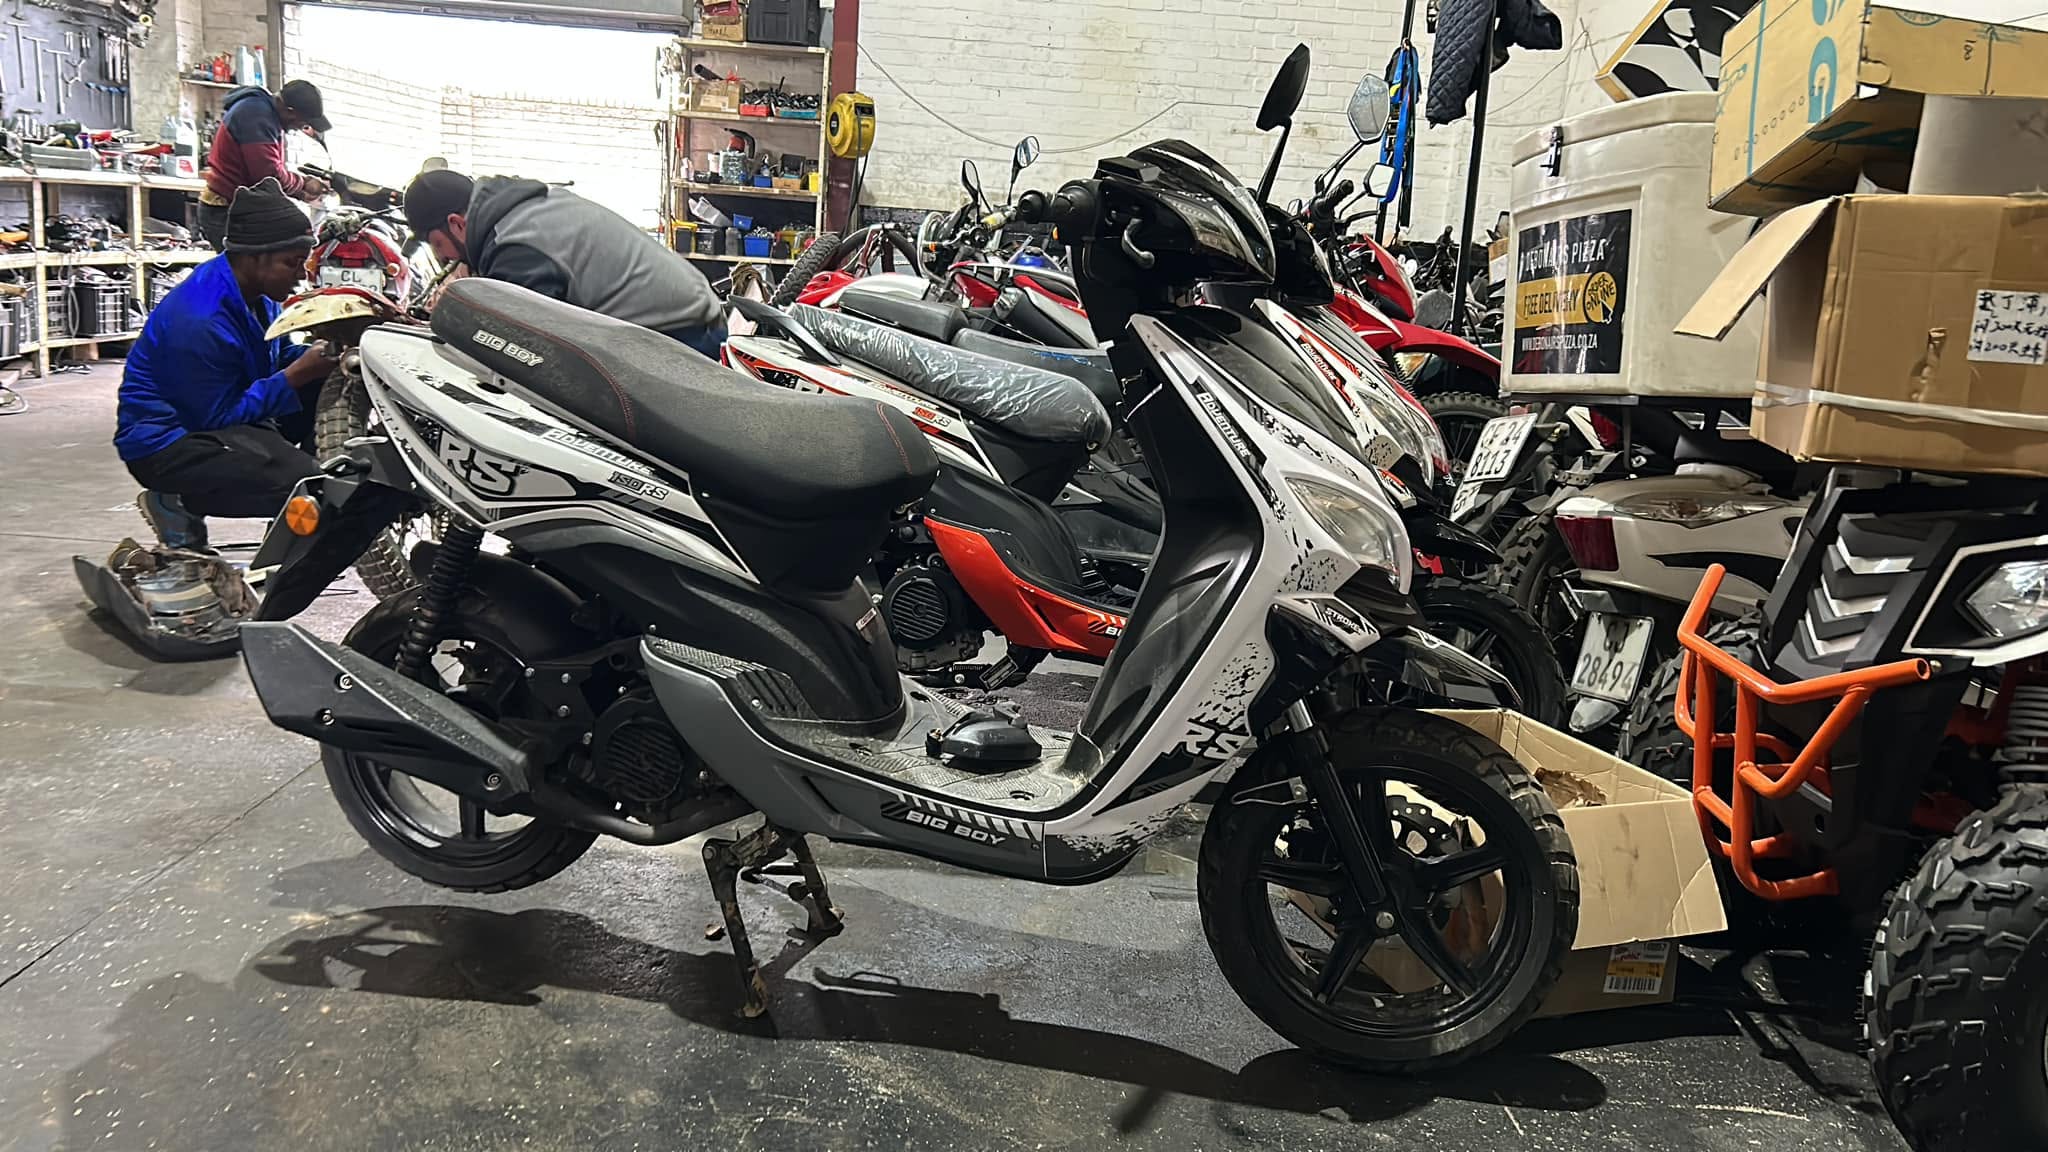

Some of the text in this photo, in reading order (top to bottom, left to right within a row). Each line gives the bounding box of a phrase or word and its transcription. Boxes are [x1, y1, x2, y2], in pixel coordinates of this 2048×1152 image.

[1571, 238, 1608, 264] PIZZA
[341, 270, 361, 283] CL
[1523, 293, 1539, 316] FREE
[1586, 281, 1615, 311] ONLINE
[472, 329, 544, 367] BIG BOY
[440, 429, 516, 493] RS
[1470, 449, 1511, 477] 8113
[1105, 626, 1122, 637] BI
[1577, 652, 1638, 695] 28494
[1184, 721, 1251, 760] RS
[906, 810, 1006, 845] BIG BOY
